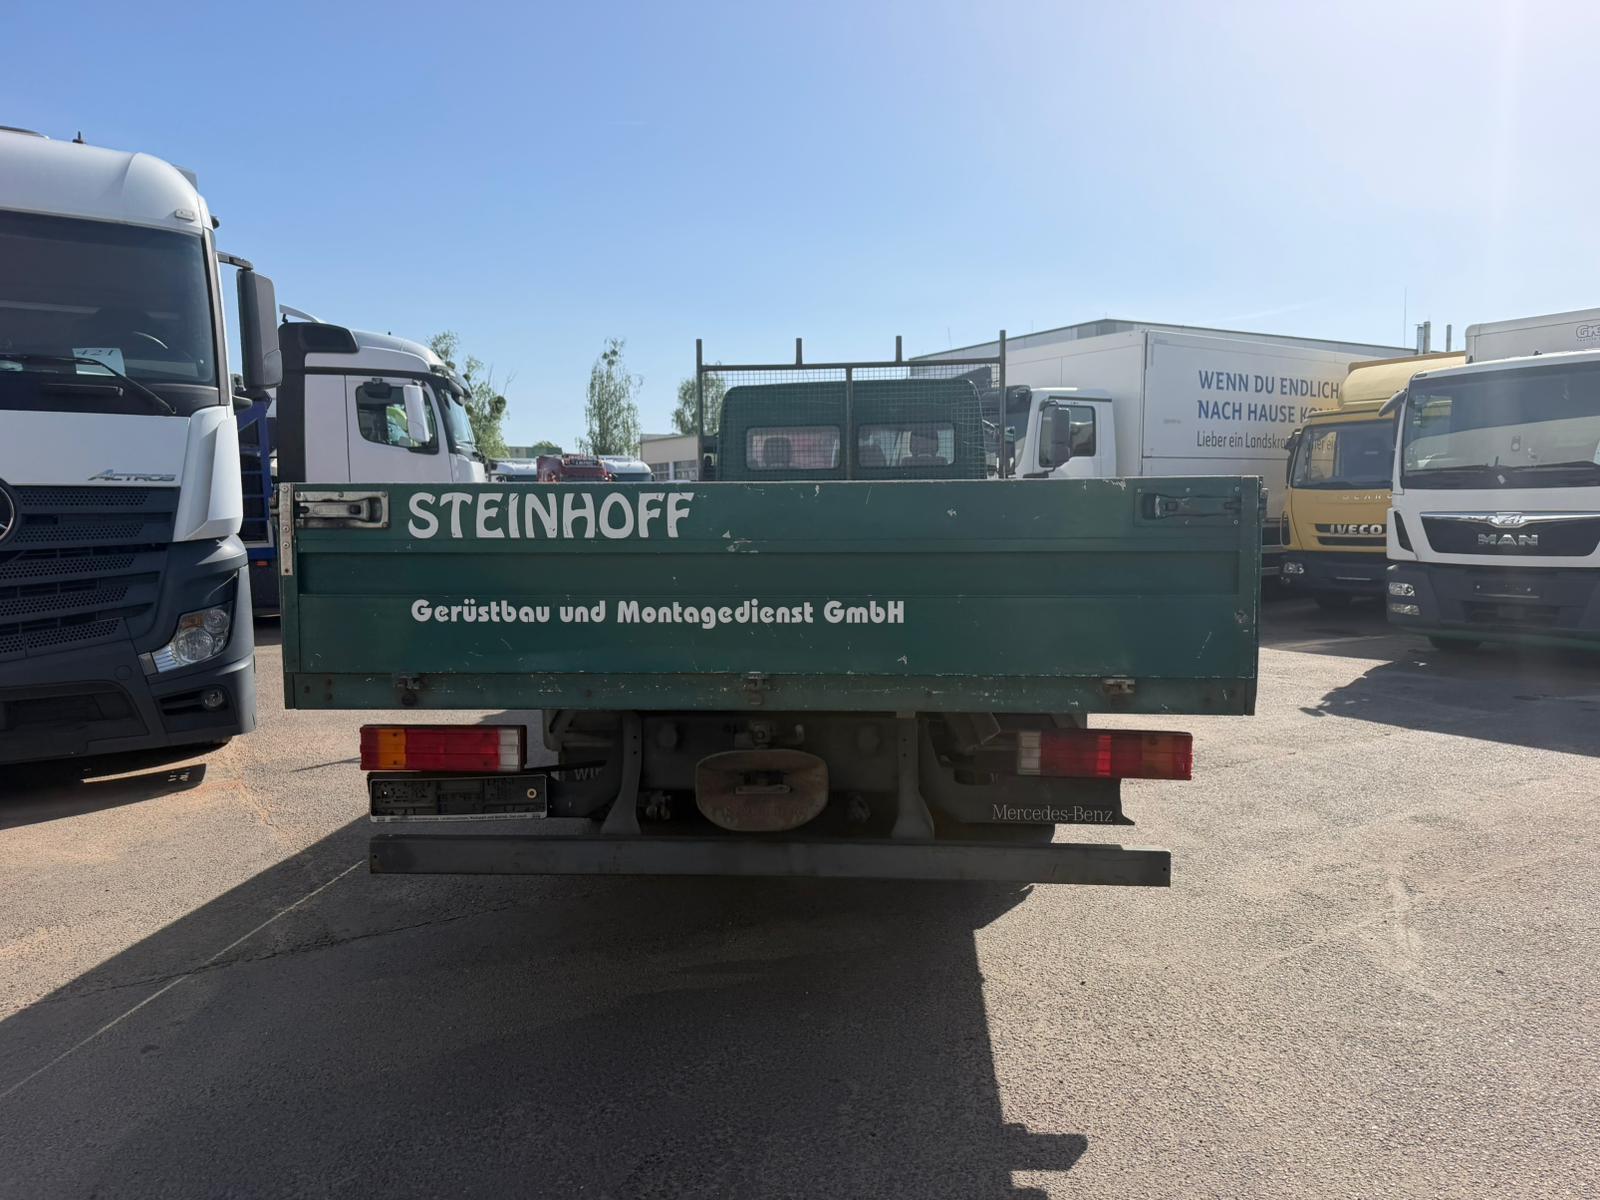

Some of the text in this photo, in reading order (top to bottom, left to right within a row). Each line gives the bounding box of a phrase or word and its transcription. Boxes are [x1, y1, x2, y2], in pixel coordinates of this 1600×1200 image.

[1199, 370, 1339, 399] WENN DU ENDLICH
[1197, 400, 1242, 420] NACH
[1248, 403, 1295, 423] HAUSE
[1196, 430, 1227, 448] Lieber
[1229, 432, 1243, 448] ein
[408, 492, 694, 539] STEINHOFF
[1329, 524, 1383, 536] IVECO
[1478, 534, 1539, 546] MAN
[411, 598, 905, 629] Gerüstbau und Montagedienst GmbH
[992, 803, 1113, 822] Mercedes-Benz
